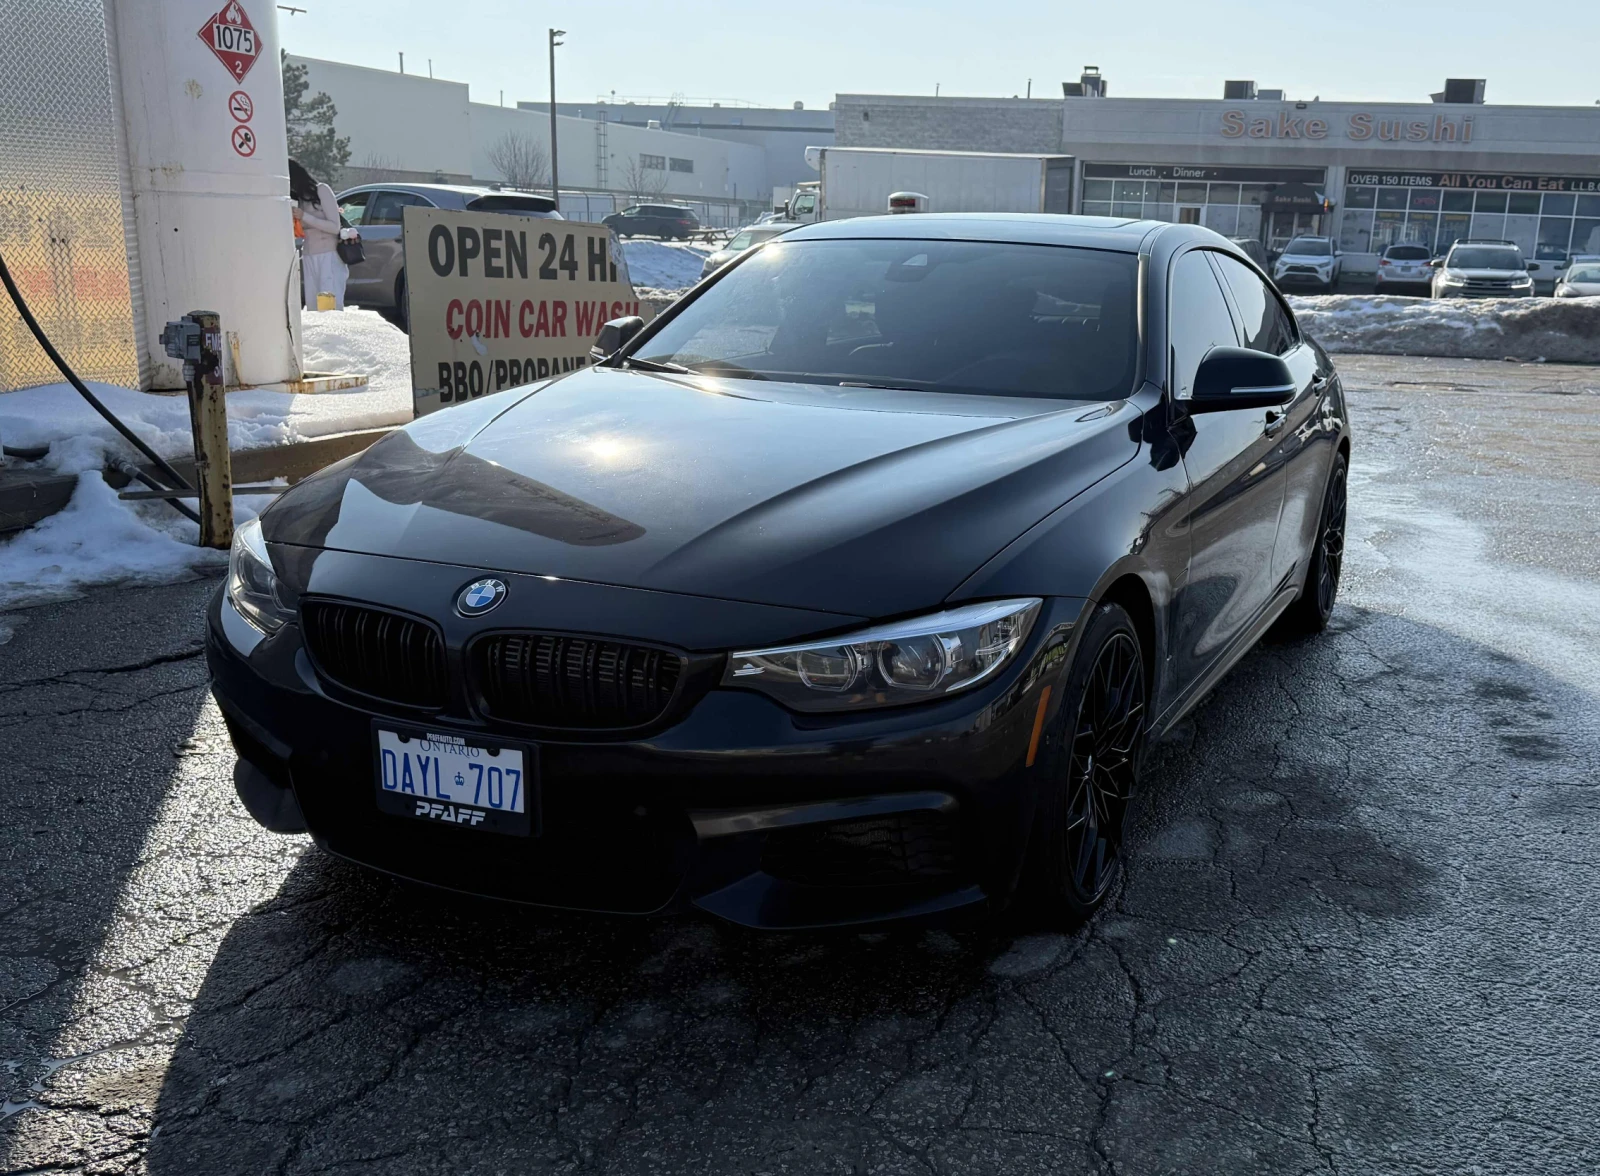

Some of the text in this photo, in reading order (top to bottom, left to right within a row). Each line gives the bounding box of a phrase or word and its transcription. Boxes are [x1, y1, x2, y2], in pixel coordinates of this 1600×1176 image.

[215, 25, 253, 53] 1075
[235, 61, 243, 74] 2
[1220, 109, 1475, 143] Sake Sushi
[1129, 166, 1206, 178] Lunch Dinner
[1351, 174, 1379, 185] OVER
[1381, 176, 1399, 186] 150
[1400, 176, 1433, 187] ITEMS
[1439, 174, 1460, 188] All
[1466, 174, 1497, 189] You
[1501, 175, 1533, 190] Can
[1537, 177, 1565, 191] Eat
[428, 224, 617, 282] OPEN 24 H
[446, 298, 511, 340] COIN
[518, 299, 568, 338] CAR
[420, 739, 480, 758] ONTARIO
[382, 748, 521, 811] DAYL 707
[415, 801, 486, 825] PFAFF
